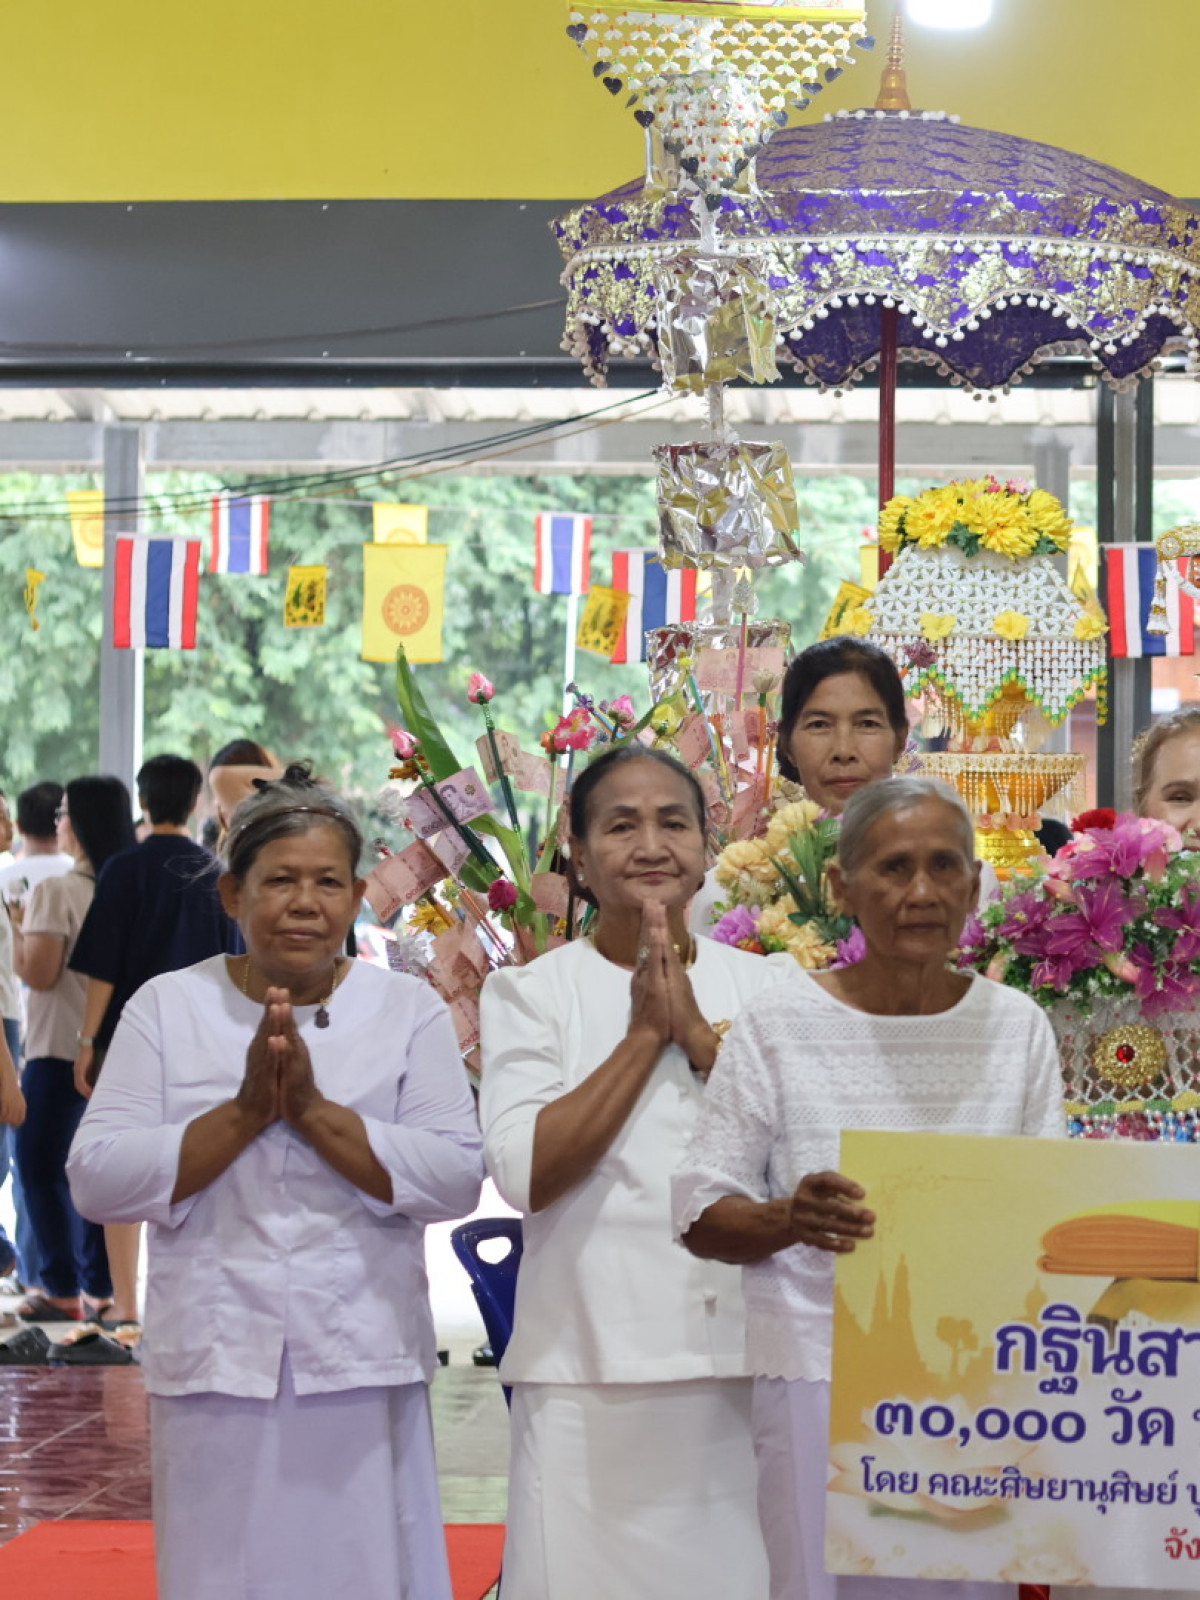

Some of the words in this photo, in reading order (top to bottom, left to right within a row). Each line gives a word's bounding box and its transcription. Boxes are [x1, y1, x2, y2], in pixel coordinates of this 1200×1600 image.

[875, 1402, 1087, 1447] ๓๐,๐๐๐
[1103, 1387, 1175, 1447] วัด
[860, 1456, 919, 1494] โดย
[928, 1465, 1179, 1515] คณะศิษยานุศิษย์
